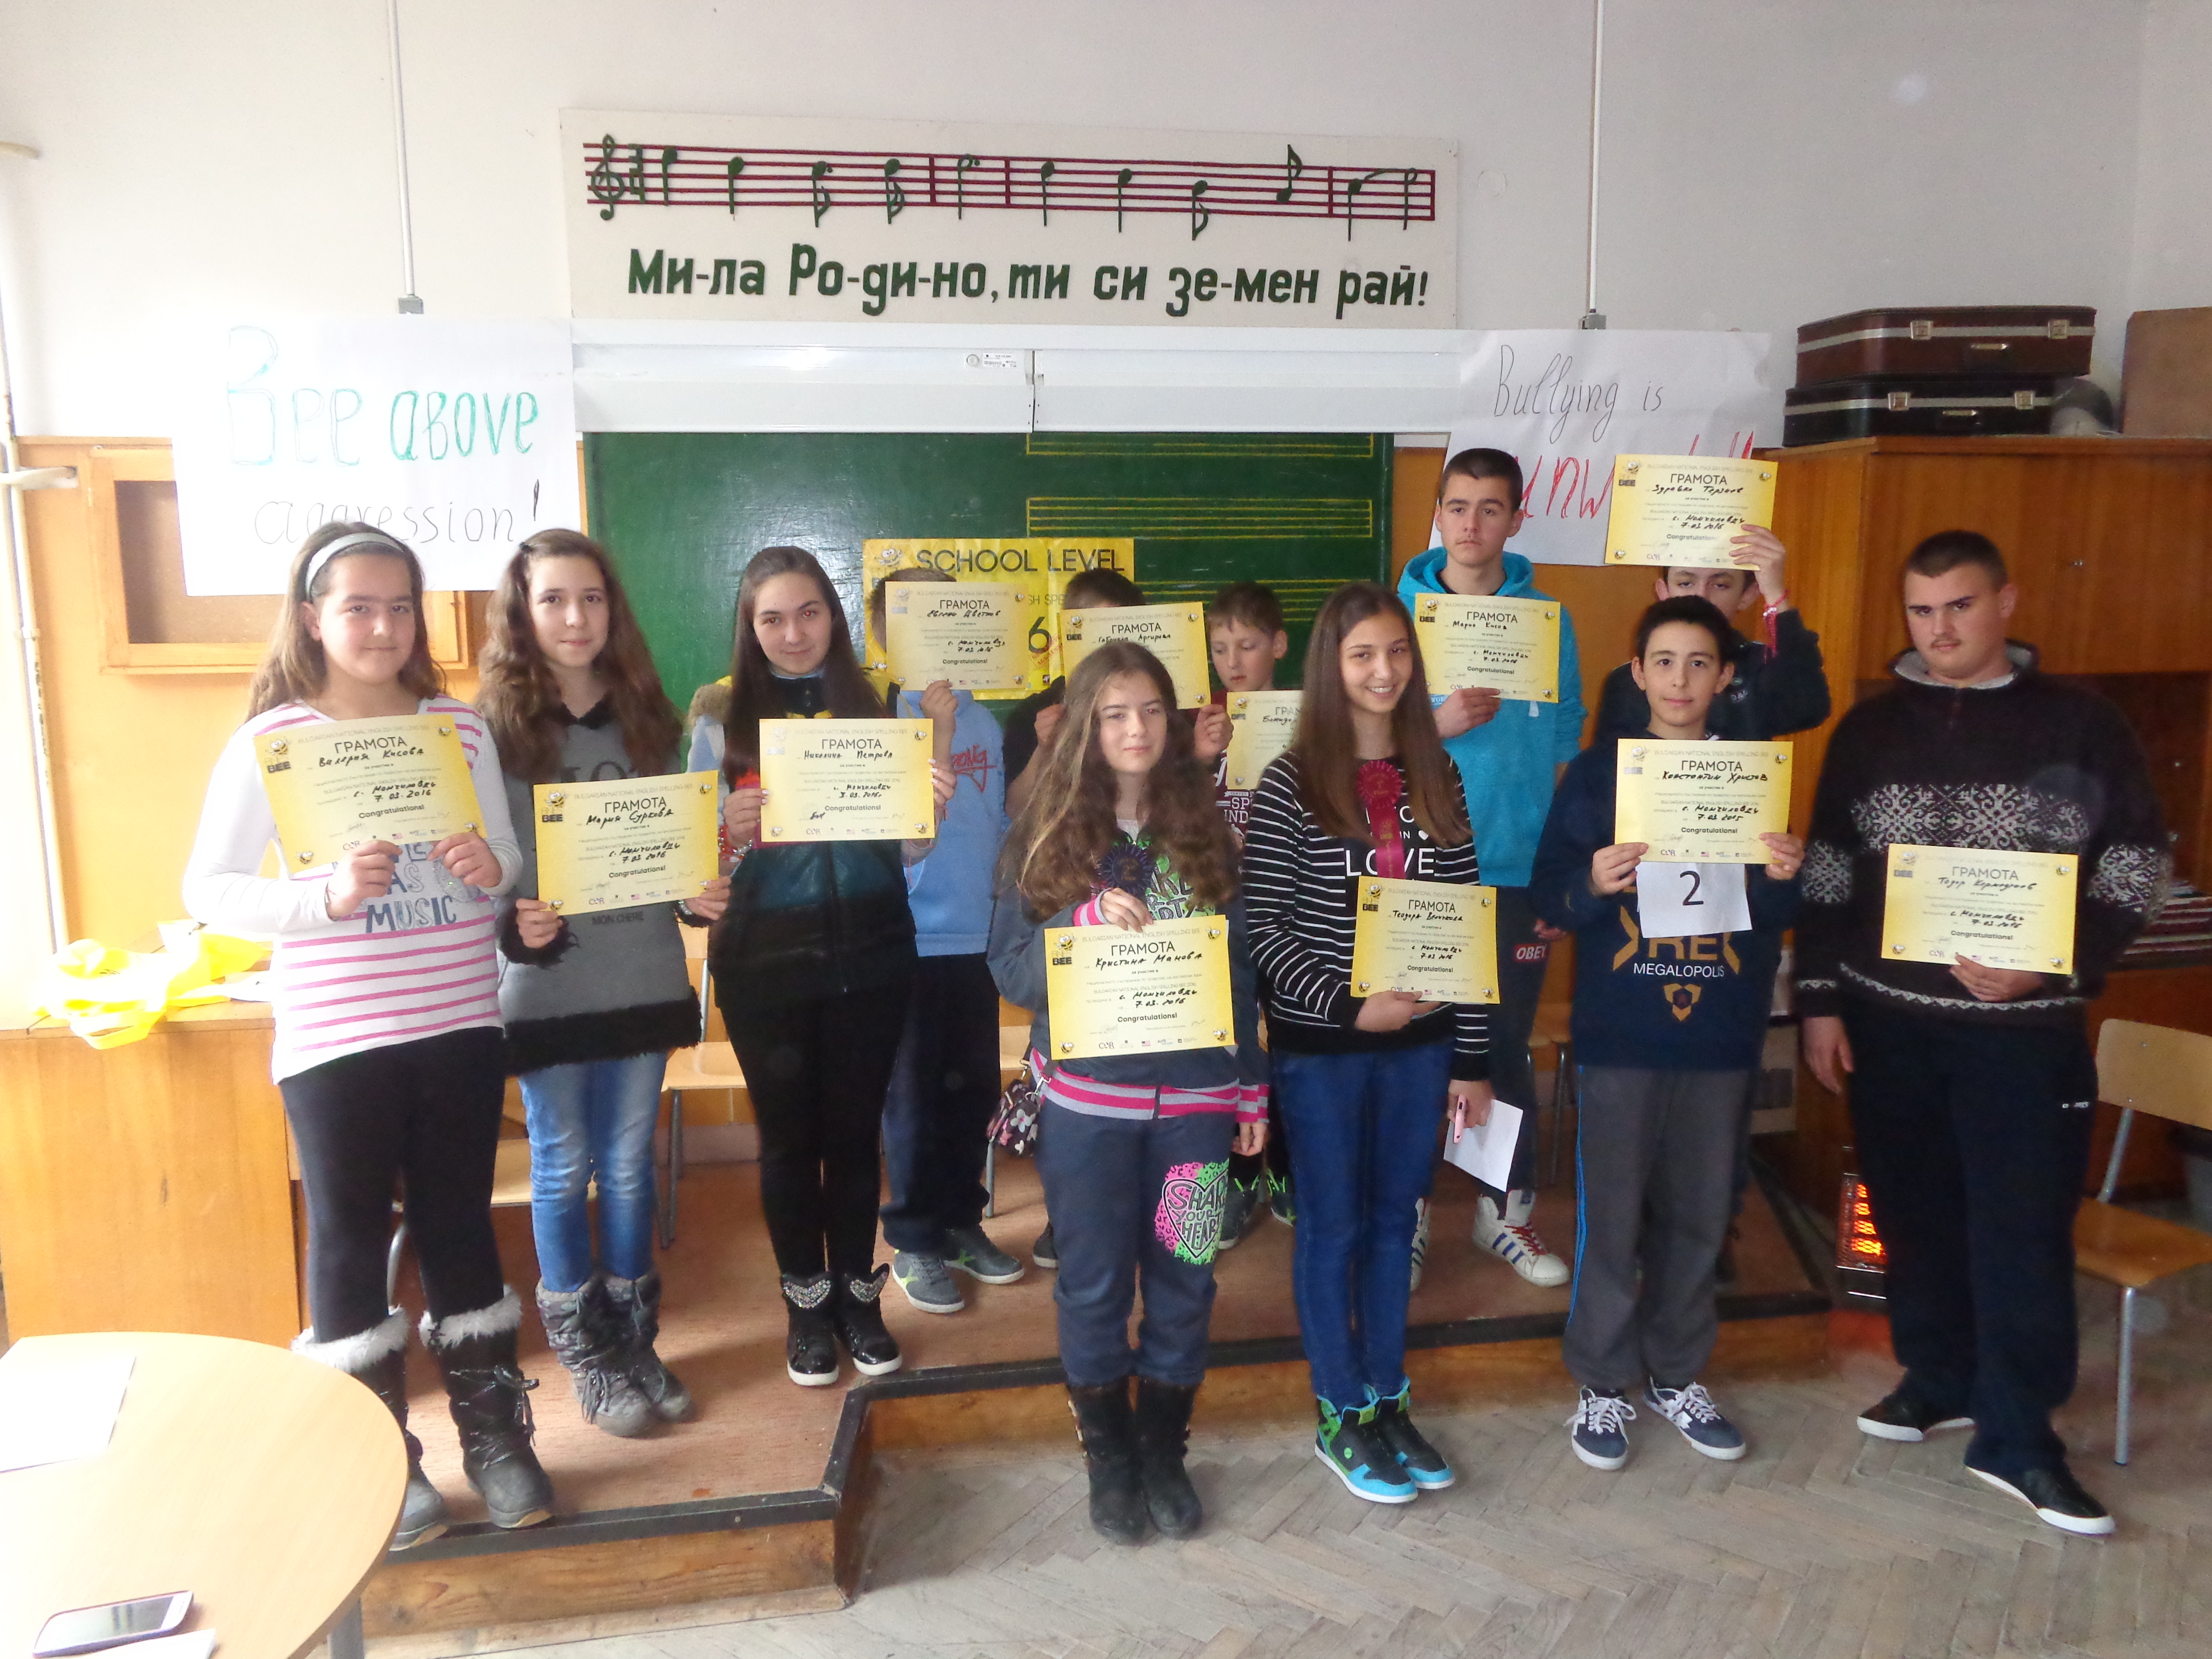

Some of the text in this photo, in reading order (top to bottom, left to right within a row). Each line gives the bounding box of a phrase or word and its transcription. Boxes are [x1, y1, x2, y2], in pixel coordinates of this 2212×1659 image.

[628, 248, 766, 295] Ми-ла
[1094, 265, 1148, 301] си
[1166, 266, 1319, 316] зе-мен
[1335, 265, 1429, 320] рай!
[1494, 345, 1664, 445] Bullying is
[389, 390, 539, 460] above
[1671, 474, 1727, 485] ГРАМОТА
[917, 549, 1124, 574] SCHOOL LEVEL
[940, 600, 989, 609] ГРАМОТА
[1467, 612, 1518, 623] ГРАМОТА
[1112, 622, 1162, 634] ГРАМОТА
[1453, 621, 1476, 629] Марио
[334, 736, 408, 754] ГРАМОТА
[822, 739, 882, 749] ГРАМОТА
[804, 750, 892, 761] Николина Петрова
[1682, 760, 1742, 771] ГРАМОТА
[1662, 771, 1721, 780] Константин
[359, 804, 424, 818] Congratulations!
[605, 797, 666, 813] ГРАМОТА
[587, 807, 674, 829] Мария Суркова
[609, 866, 666, 878] Congratulations!
[1952, 866, 2018, 880] ГРАМОТА
[1680, 871, 1704, 905] 2
[1409, 900, 1455, 913] ГРАМОТА
[366, 895, 457, 933] MUSIC
[1393, 910, 1421, 921] Теодора
[1951, 930, 2013, 940] Congratulations!
[1111, 941, 1175, 956] ГРАМОТА
[1516, 945, 1547, 960] OBEY
[1096, 951, 1202, 971] Кристина Манова
[1634, 963, 1724, 977] MEGALOPOLIS
[1118, 1012, 1177, 1022] Congratulations!
[1168, 1176, 1226, 1212] SHAR
[1172, 1209, 1213, 1224] YOUR
